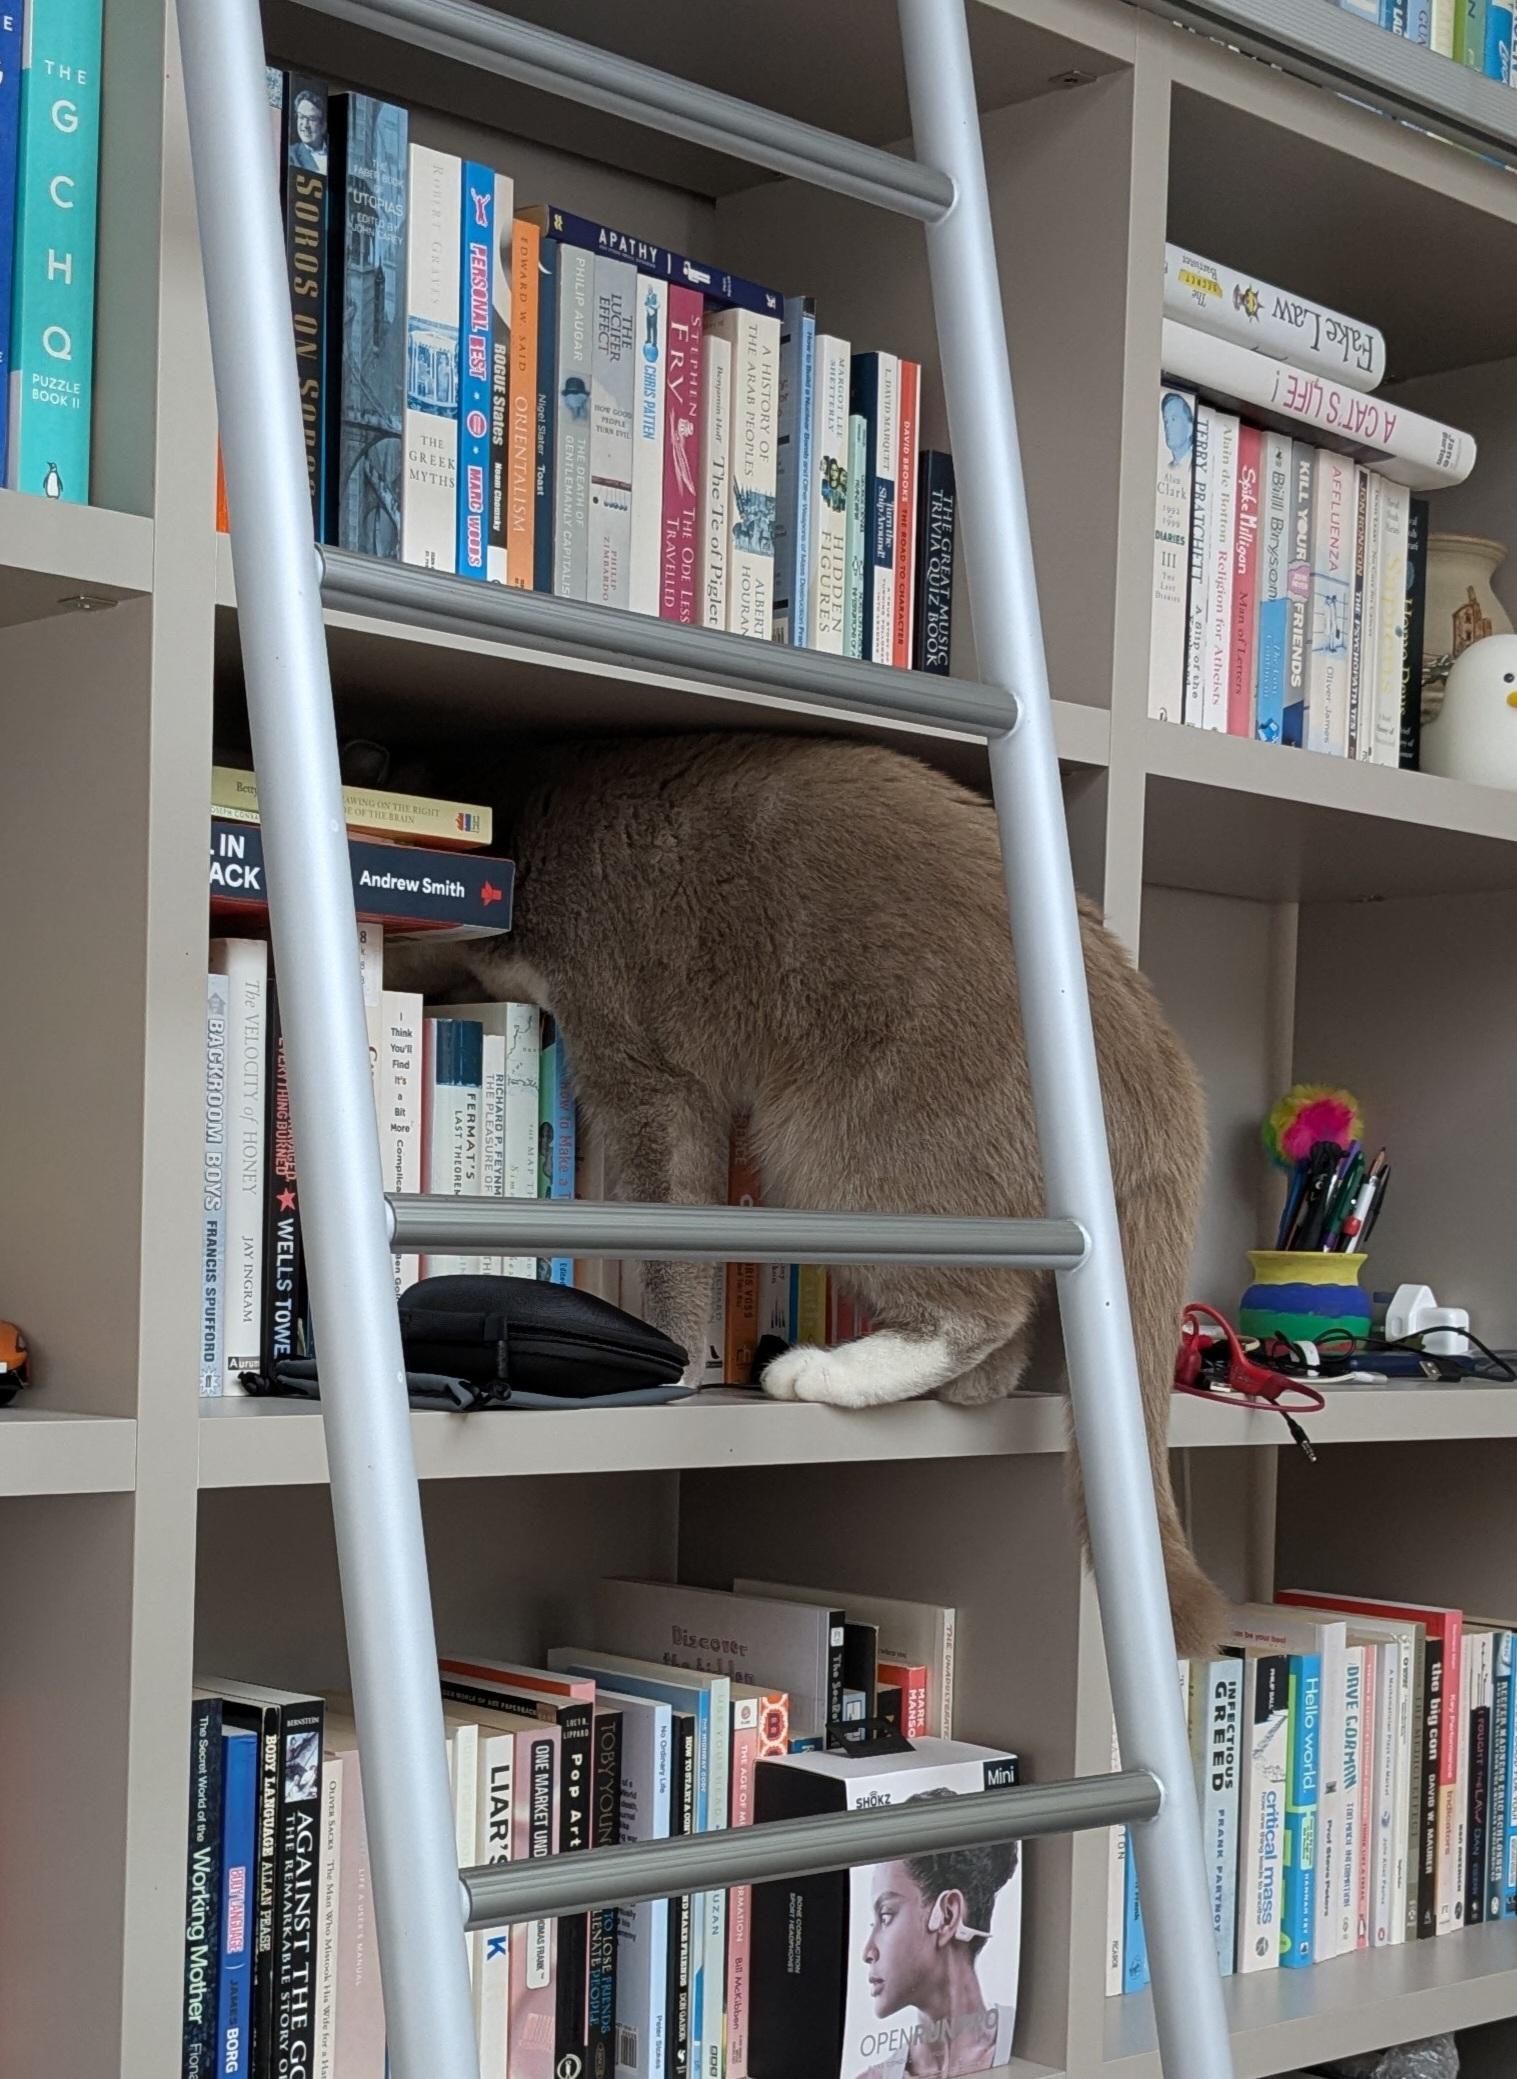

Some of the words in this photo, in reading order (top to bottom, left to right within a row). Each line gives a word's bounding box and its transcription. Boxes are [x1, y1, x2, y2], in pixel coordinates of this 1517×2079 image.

[44, 59, 87, 85] THE
[352, 192, 404, 217] UTOPIAS
[356, 213, 385, 231] EDITED
[387, 222, 400, 232] BY
[294, 175, 323, 298] SOROS
[598, 228, 658, 263] APATHY
[468, 242, 490, 333] PERSONAL
[574, 257, 586, 307] PHILIP
[295, 314, 318, 360] ON
[573, 311, 584, 361] AUGAR
[598, 295, 612, 356] EFFECT
[609, 293, 623, 363] LUCIFER
[622, 315, 634, 350] THE
[746, 324, 758, 356] THE
[1272, 297, 1321, 352] Law
[1326, 318, 1374, 373] Fake
[468, 335, 488, 380] BEST
[493, 343, 507, 397] ROGUE
[667, 322, 689, 404] FRY
[688, 315, 701, 417] STEPHEN
[32, 373, 80, 396] PUZZLE
[643, 364, 657, 398] CHRIS
[714, 366, 724, 415] Benjamin
[745, 361, 756, 405] ARAB
[1283, 375, 1324, 418] LIFE
[492, 399, 506, 447] States
[641, 401, 656, 440] PATTEN
[1327, 391, 1379, 439] CAT'S
[1383, 412, 1397, 444] A
[409, 450, 456, 471] GREEK
[420, 435, 445, 449] THE
[742, 411, 755, 477] PEOPLES
[1195, 419, 1209, 474] TERRY
[1220, 424, 1233, 465] Alain
[410, 469, 456, 489] MYTHS
[494, 463, 503, 488] Noam
[513, 396, 529, 533] ORIENTALISM
[711, 457, 725, 500] The
[1219, 469, 1231, 489] de
[1298, 461, 1311, 502] KILL
[467, 465, 484, 514] MARC
[1157, 482, 1186, 500] Clark
[1238, 465, 1257, 511] Spike
[1270, 471, 1286, 511] Bill
[492, 489, 503, 532] Chomsky
[682, 507, 696, 541] THE
[710, 505, 724, 533] Te
[930, 489, 943, 551] TRIVIA
[942, 495, 953, 533] THE
[1191, 481, 1207, 584] PRATCHETT
[1218, 493, 1230, 543] Botton
[1329, 466, 1343, 573] AFFLUENZA
[467, 515, 482, 568] WOODS
[710, 537, 723, 562] of
[1155, 530, 1185, 547] DIARIES
[1236, 512, 1258, 577] Milligan
[1296, 508, 1309, 561] YOUR
[664, 517, 681, 608] TRAVELLED
[681, 548, 695, 581] ODE
[819, 531, 832, 632] FIGURES
[926, 557, 940, 606] QUIZ
[940, 539, 951, 599] GREAT
[1161, 552, 1176, 568] III
[1267, 517, 1285, 602] Bryson
[706, 564, 723, 625] Piglet
[831, 535, 844, 633] HIDDEN
[1215, 551, 1228, 613] Religion
[679, 590, 693, 624] LESS
[753, 579, 765, 640] ALBERT
[1214, 617, 1226, 641] for
[926, 612, 938, 667] BOOK
[937, 605, 949, 666] MUSIC
[1291, 601, 1306, 688] FRIENDS
[1211, 645, 1223, 706] Atheists
[219, 834, 245, 859] IN
[360, 870, 419, 893] Andrew
[422, 878, 465, 898] Smith
[245, 979, 261, 1008] The
[391, 1027, 413, 1038] Think
[391, 1044, 413, 1056] You'll
[243, 1014, 260, 1101] VELOCITY
[392, 1060, 410, 1071] Find
[206, 1018, 225, 1144] BACKROOM
[395, 1076, 407, 1086] It's
[486, 1074, 495, 1098] THE
[240, 1105, 259, 1125] of
[391, 1122, 410, 1135] More
[395, 1107, 406, 1118] Bit
[466, 1093, 477, 1181] FERMAT'S
[485, 1103, 494, 1174] PLEASURE
[203, 1151, 223, 1212] BOYS
[241, 1130, 258, 1195] HONEY
[483, 1178, 492, 1193] OF
[205, 1220, 218, 1283] FRANCIS
[242, 1236, 254, 1261] JAY
[276, 1218, 295, 1292] WELLS
[242, 1264, 253, 1322] INGRAM
[204, 1287, 216, 1363] SPUFFORD
[274, 1299, 293, 1360] TOWE
[1345, 1665, 1360, 1711] DAVE
[1430, 1663, 1443, 1692] the
[287, 1716, 319, 1727] BERNSTEIN
[1303, 1677, 1319, 1728] Hello
[1427, 1697, 1442, 1728] big
[264, 1734, 278, 1771] BODY
[563, 1730, 590, 1740] LIPPARD
[659, 1726, 667, 1738] No
[1212, 1681, 1227, 1791] GREED
[1225, 1681, 1237, 1789] INFECTIOUS
[1344, 1715, 1359, 1791] GORMAN
[1428, 1729, 1439, 1760] con
[568, 1753, 584, 1798] Pop
[658, 1740, 667, 1776] Ordinary
[987, 1765, 1015, 1785] Mini
[1302, 1732, 1317, 1795] world.
[327, 1780, 337, 1818] OLIVER
[658, 1777, 667, 1794] Life
[856, 1792, 892, 1809] SHOKZ
[262, 1776, 276, 1856] LANGUAGE
[284, 1814, 296, 1852] THE
[327, 1821, 336, 1850] SACKS
[569, 1810, 583, 1847] Art
[1216, 1810, 1225, 1859] FRANK
[1262, 1791, 1278, 1861] critical
[261, 1861, 274, 1905] ALLAN
[294, 1811, 314, 1953] AGAINST
[326, 1860, 335, 1880] The
[187, 1847, 212, 1941] Working
[325, 1884, 334, 1908] Man
[1214, 1866, 1223, 1933] PARTNOY
[1261, 1866, 1276, 1925] mass
[1323, 1880, 1331, 1917] Peters
[259, 1909, 273, 1952] PEASE
[281, 1860, 294, 1984] REMARKABLE
[324, 1911, 334, 1936] Who
[323, 1939, 333, 1983] Mistook
[189, 1945, 209, 2024] Mother
[292, 1962, 309, 2030] THE
[322, 1985, 331, 2003] His
[279, 1992, 290, 2051] STORY
[321, 2005, 331, 2031] Wife
[321, 2033, 330, 2048] for
